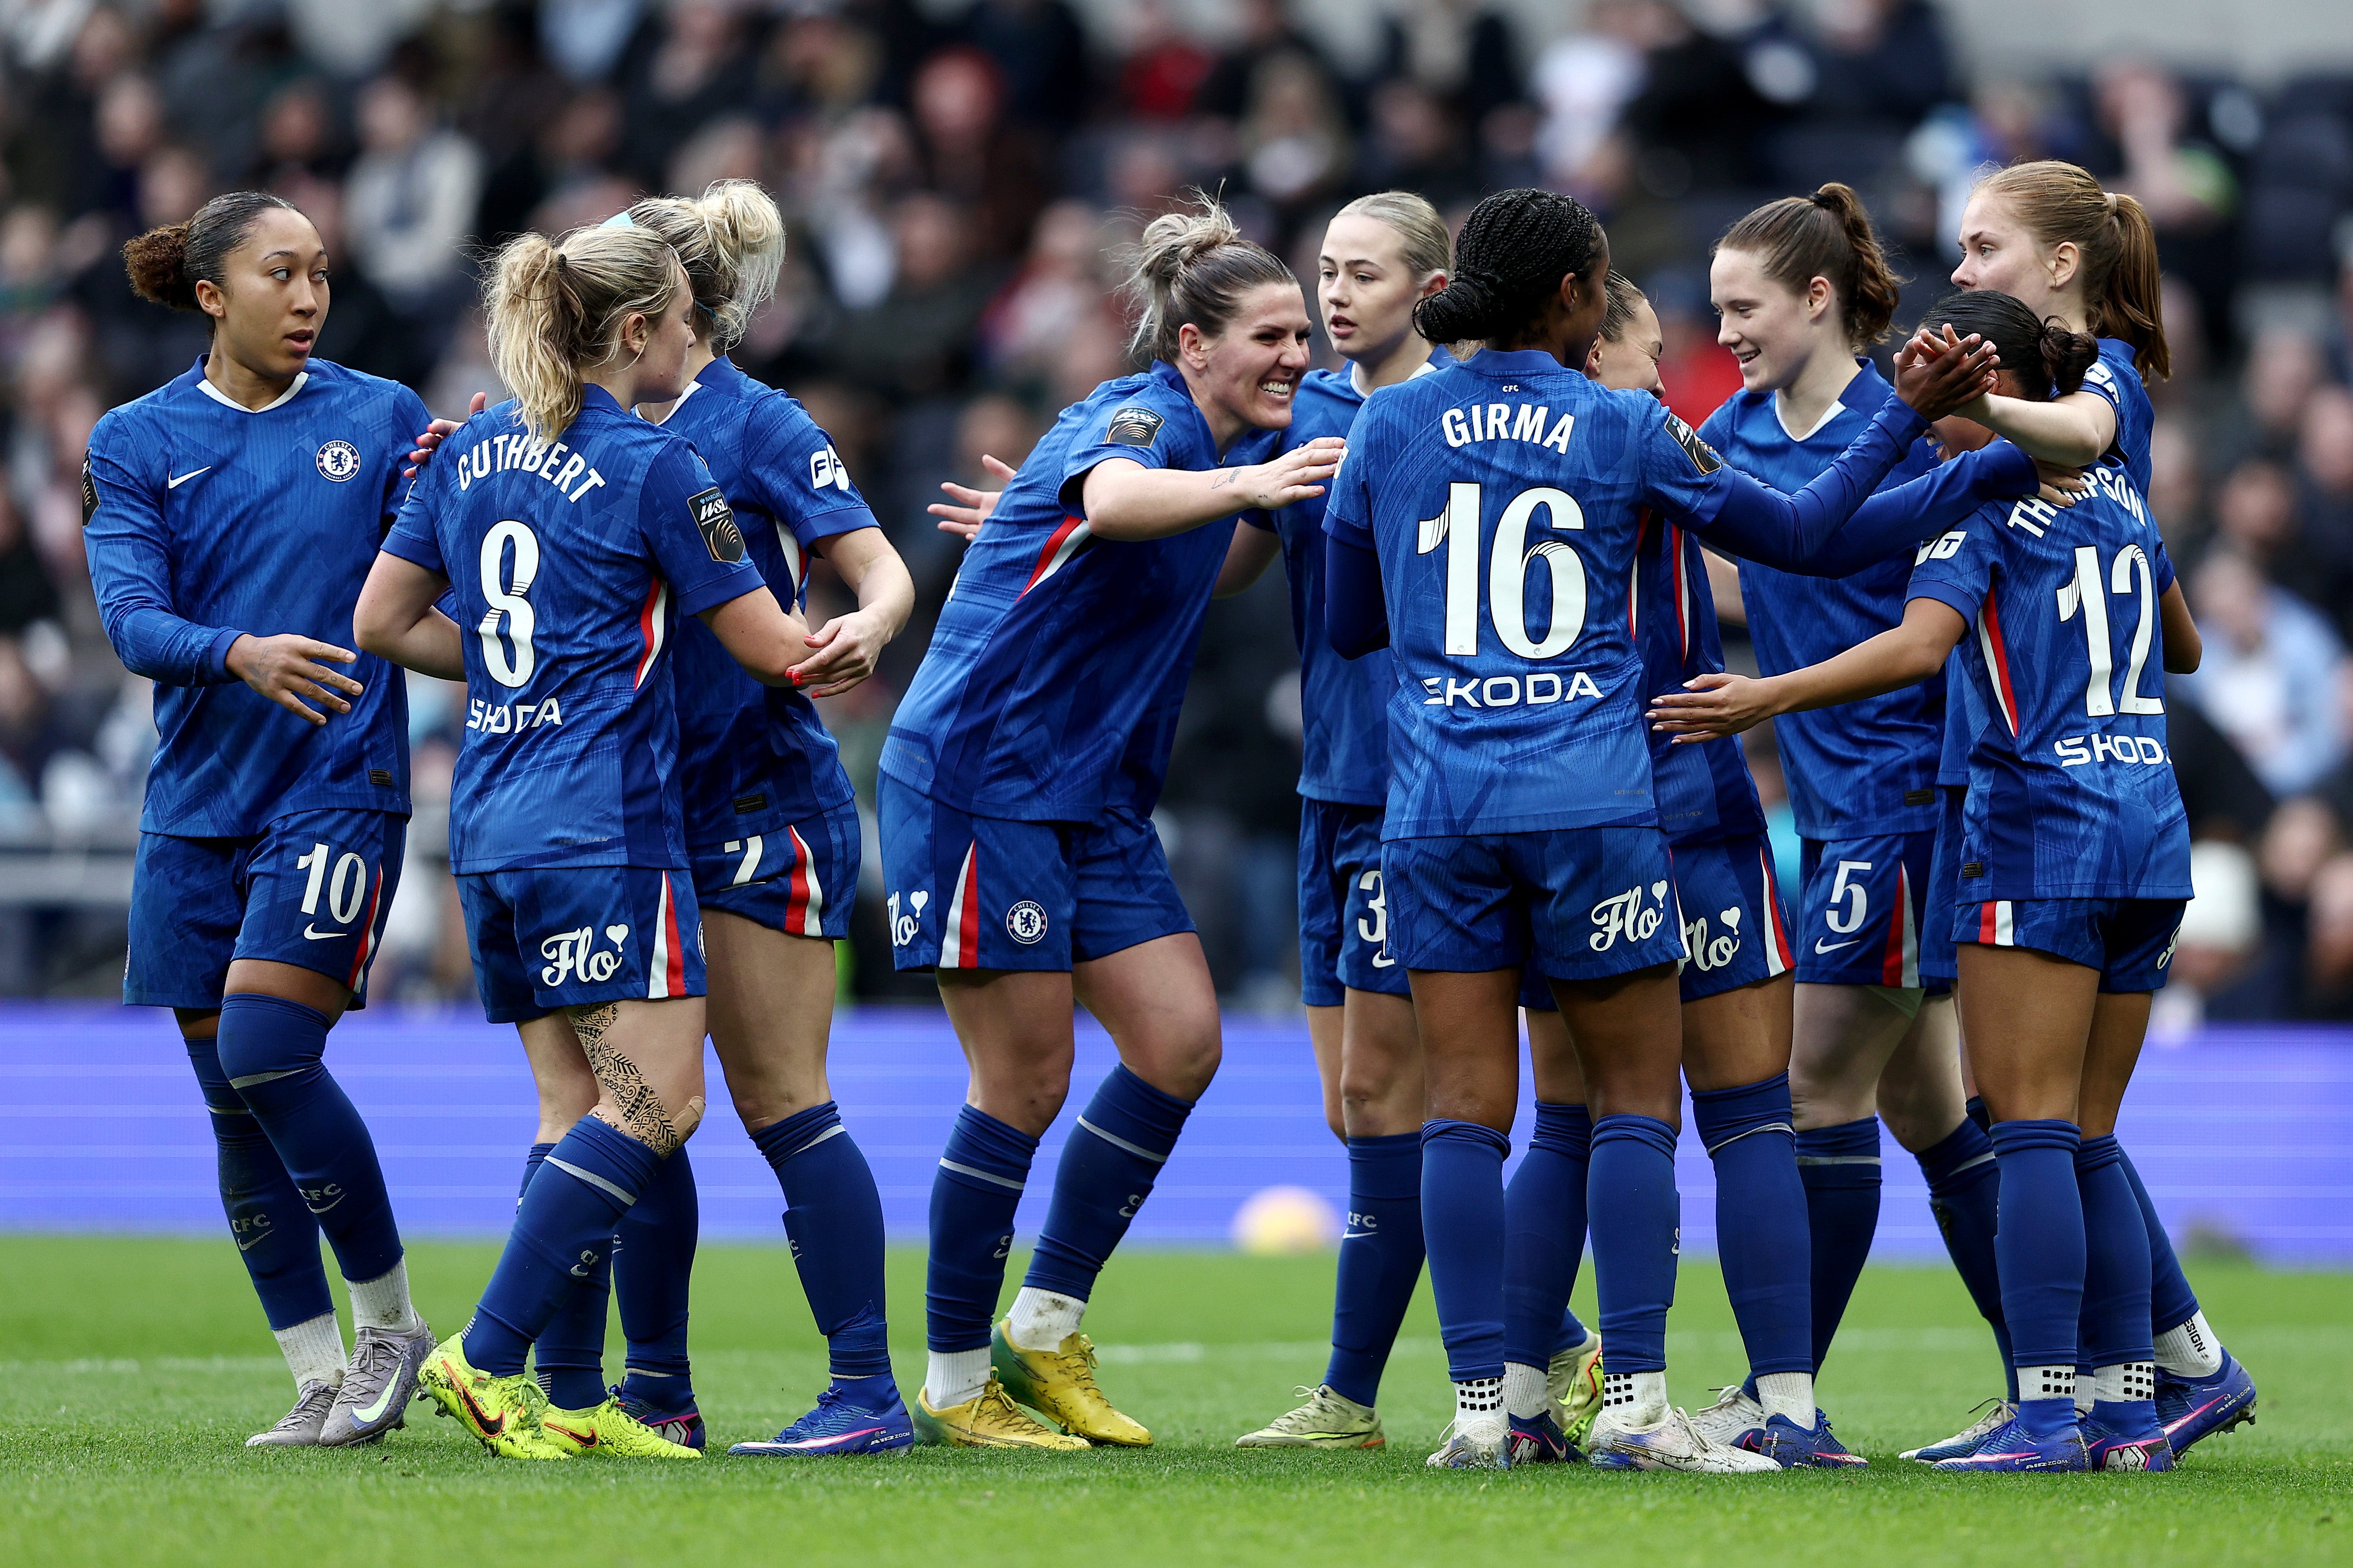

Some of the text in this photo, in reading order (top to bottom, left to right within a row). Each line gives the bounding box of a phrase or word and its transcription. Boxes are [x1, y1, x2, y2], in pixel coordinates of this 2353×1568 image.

[325, 442, 352, 452] CHELSEA
[1442, 403, 1576, 455] GIRMA
[458, 434, 606, 503] CUTHBERT
[700, 498, 728, 521] WSL
[2007, 467, 2146, 538] THPSON
[1417, 482, 1587, 660] 16
[478, 520, 539, 688] 8
[2056, 543, 2165, 718] 12
[2054, 733, 2173, 768] SKOD
[297, 843, 367, 924] 10
[724, 835, 763, 884] 7
[1014, 903, 1040, 912] CHELSEA
[1589, 885, 1664, 952] Flo
[1826, 860, 1873, 933] 5
[541, 926, 623, 986] Flo
[298, 1183, 341, 1201] CFC
[1348, 1211, 1377, 1229] CFC
[232, 1213, 271, 1233] CFC
